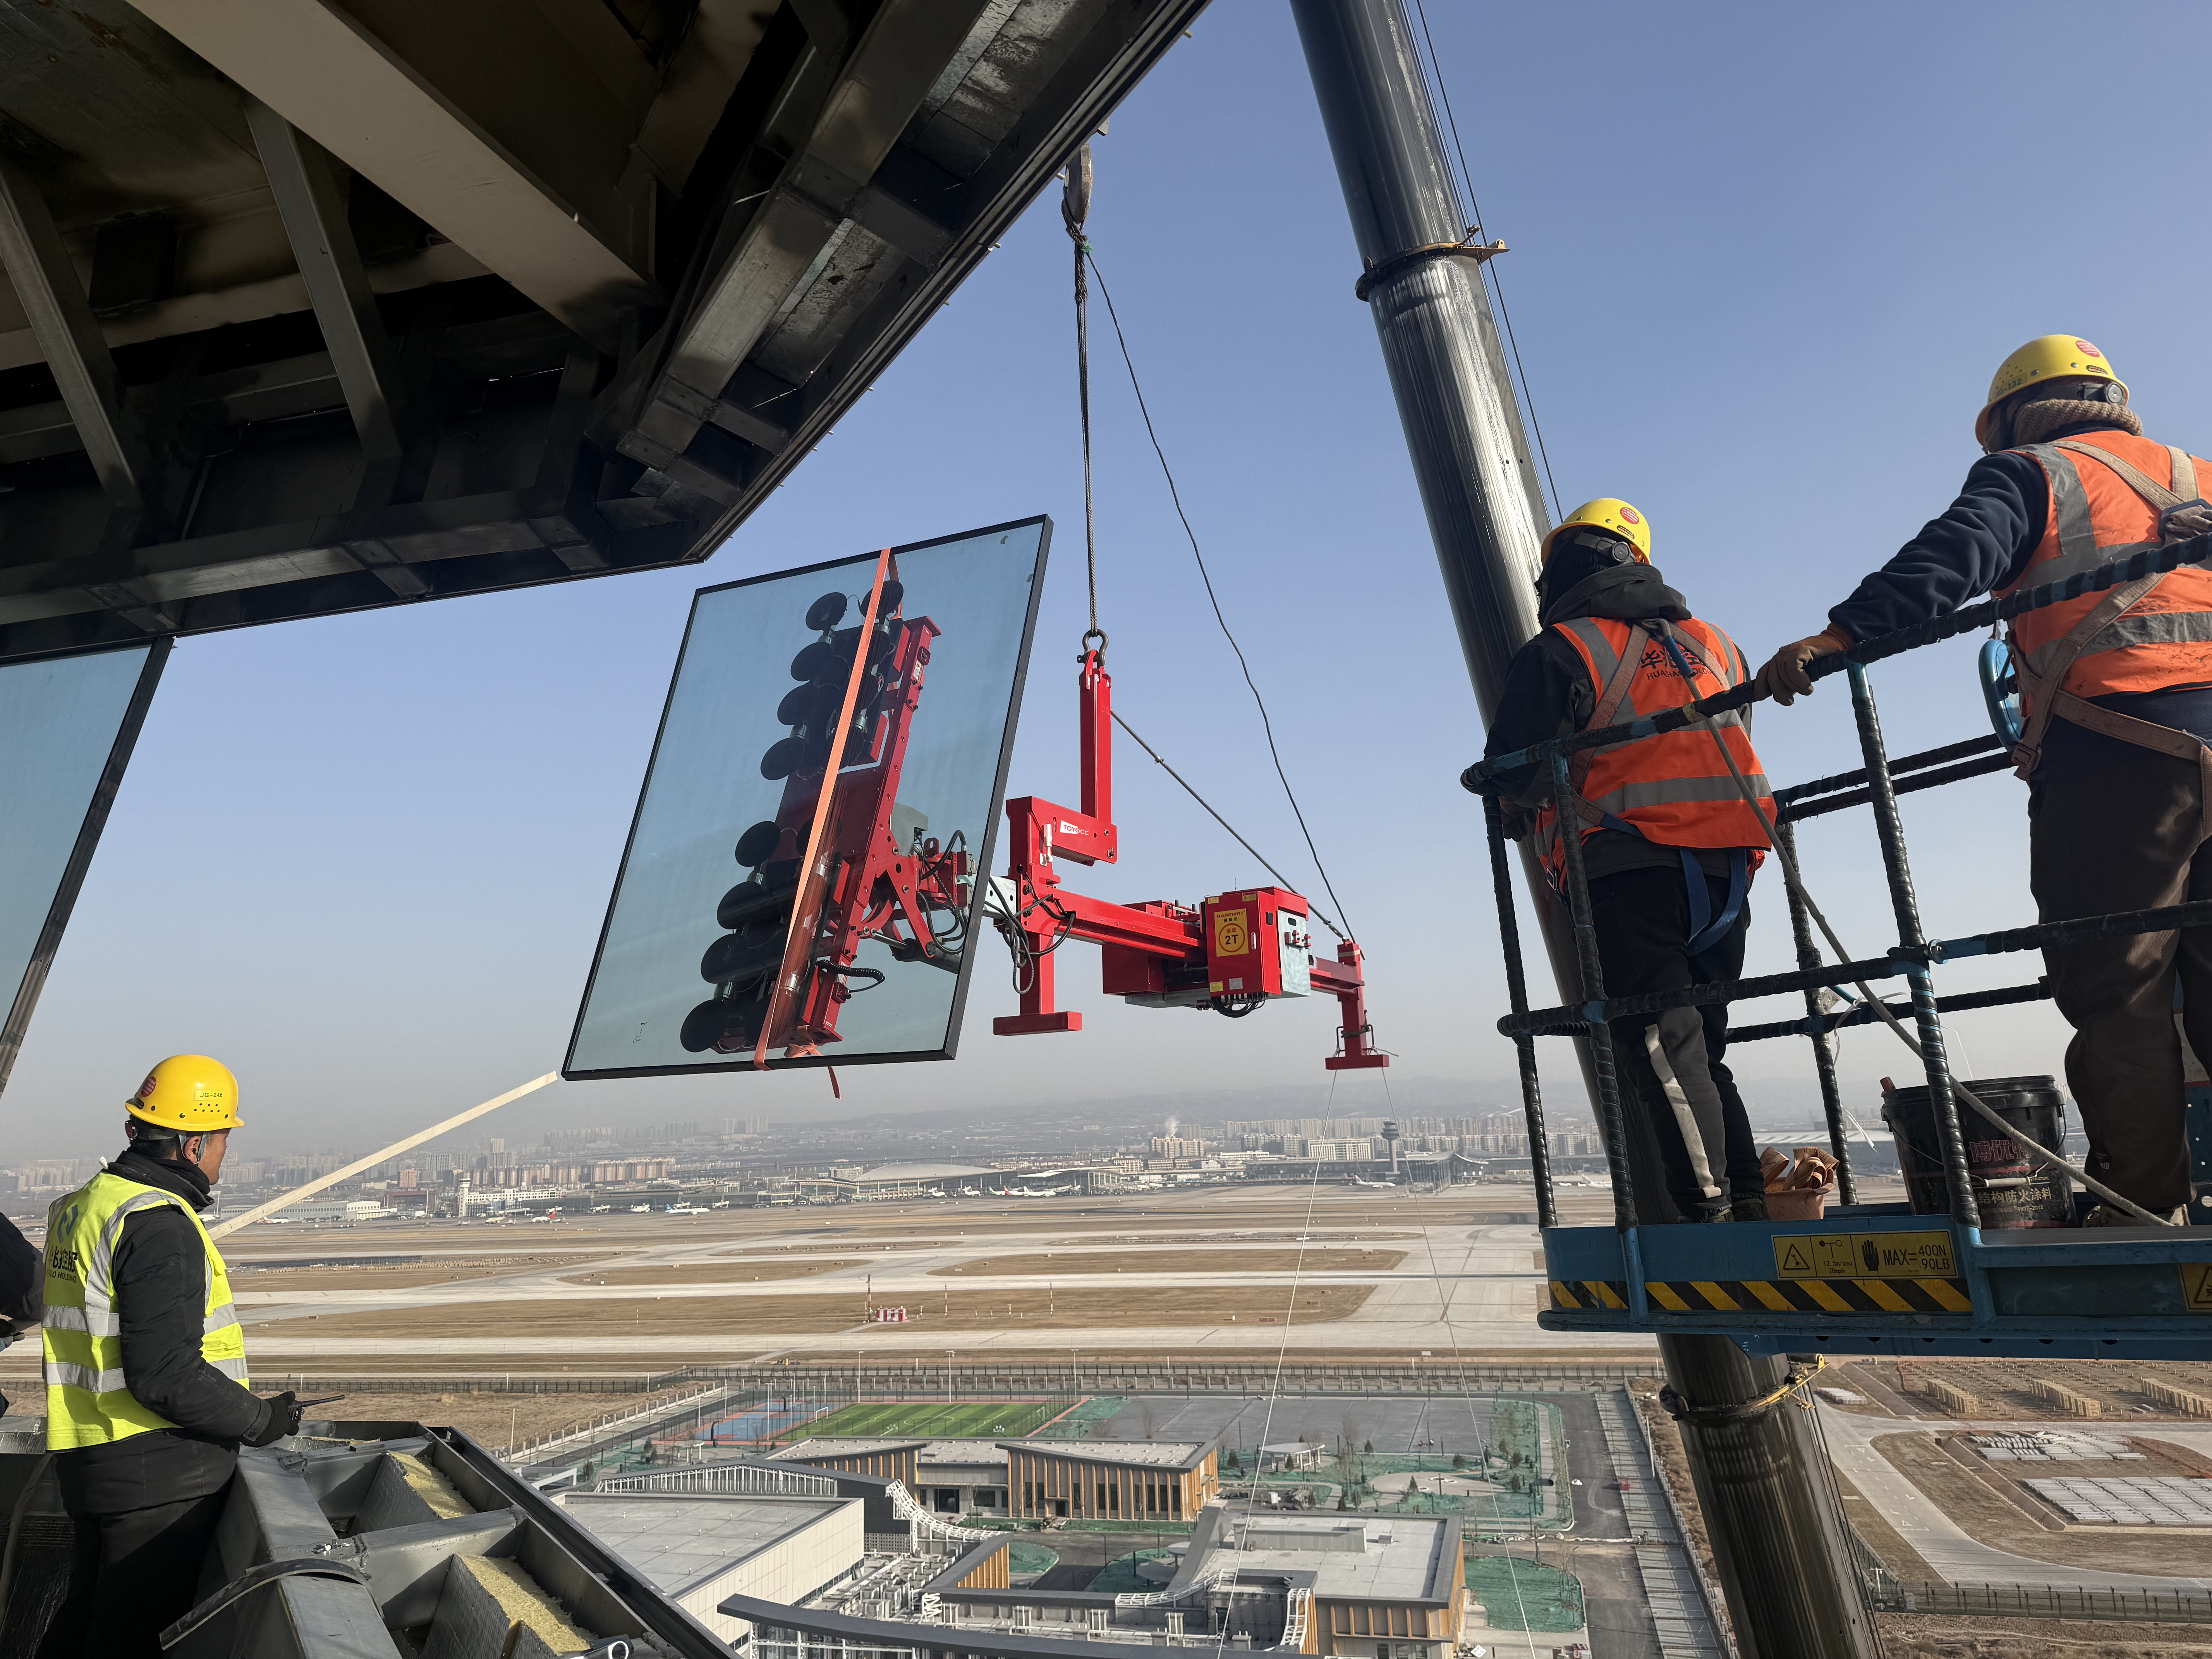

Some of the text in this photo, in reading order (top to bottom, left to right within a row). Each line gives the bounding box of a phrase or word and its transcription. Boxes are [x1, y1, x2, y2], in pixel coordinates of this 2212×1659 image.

[1063, 824, 1089, 836] TOYOCC
[1225, 934, 1238, 945] 2T
[1969, 1139, 2032, 1163] 博优特
[1973, 1187, 2052, 1204] 结构防火涂料
[1918, 1245, 1946, 1256] 400N
[1922, 1258, 1950, 1270] 90LB
